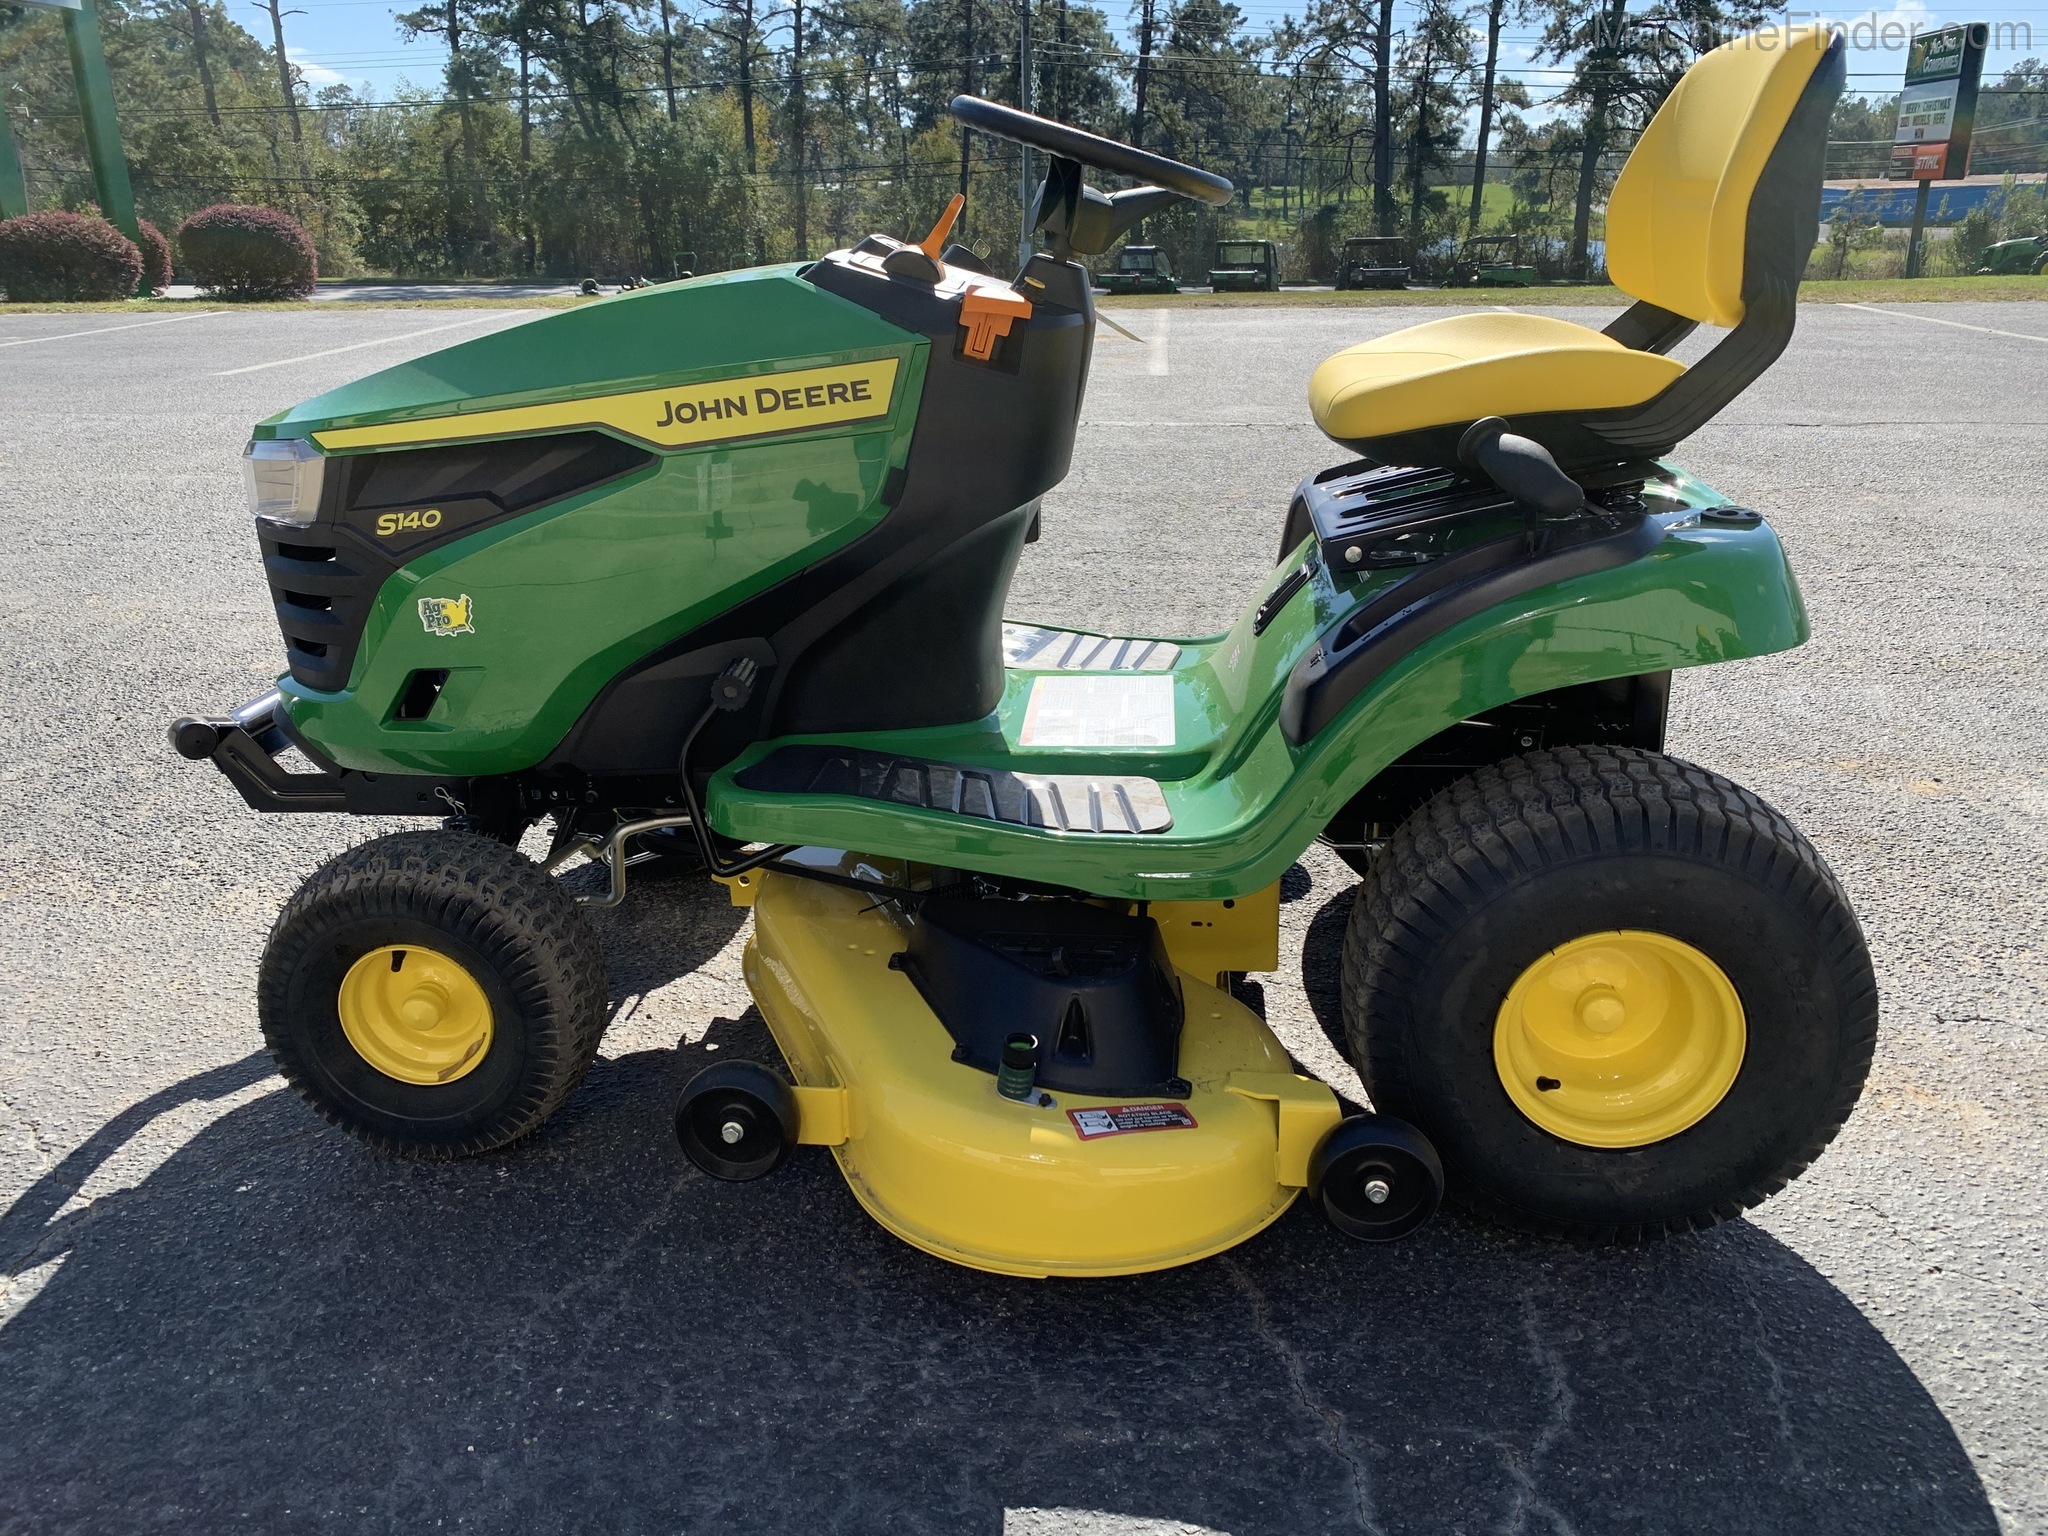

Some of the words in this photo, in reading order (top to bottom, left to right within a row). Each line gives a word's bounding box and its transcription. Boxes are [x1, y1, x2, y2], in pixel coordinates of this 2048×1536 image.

[1922, 98, 1952, 112] CHRISTMAS
[1916, 155, 1939, 170] STIHL
[657, 395, 748, 427] JOHN
[754, 379, 872, 415] DEERE
[376, 509, 442, 536] S140
[426, 614, 451, 629] Pro
